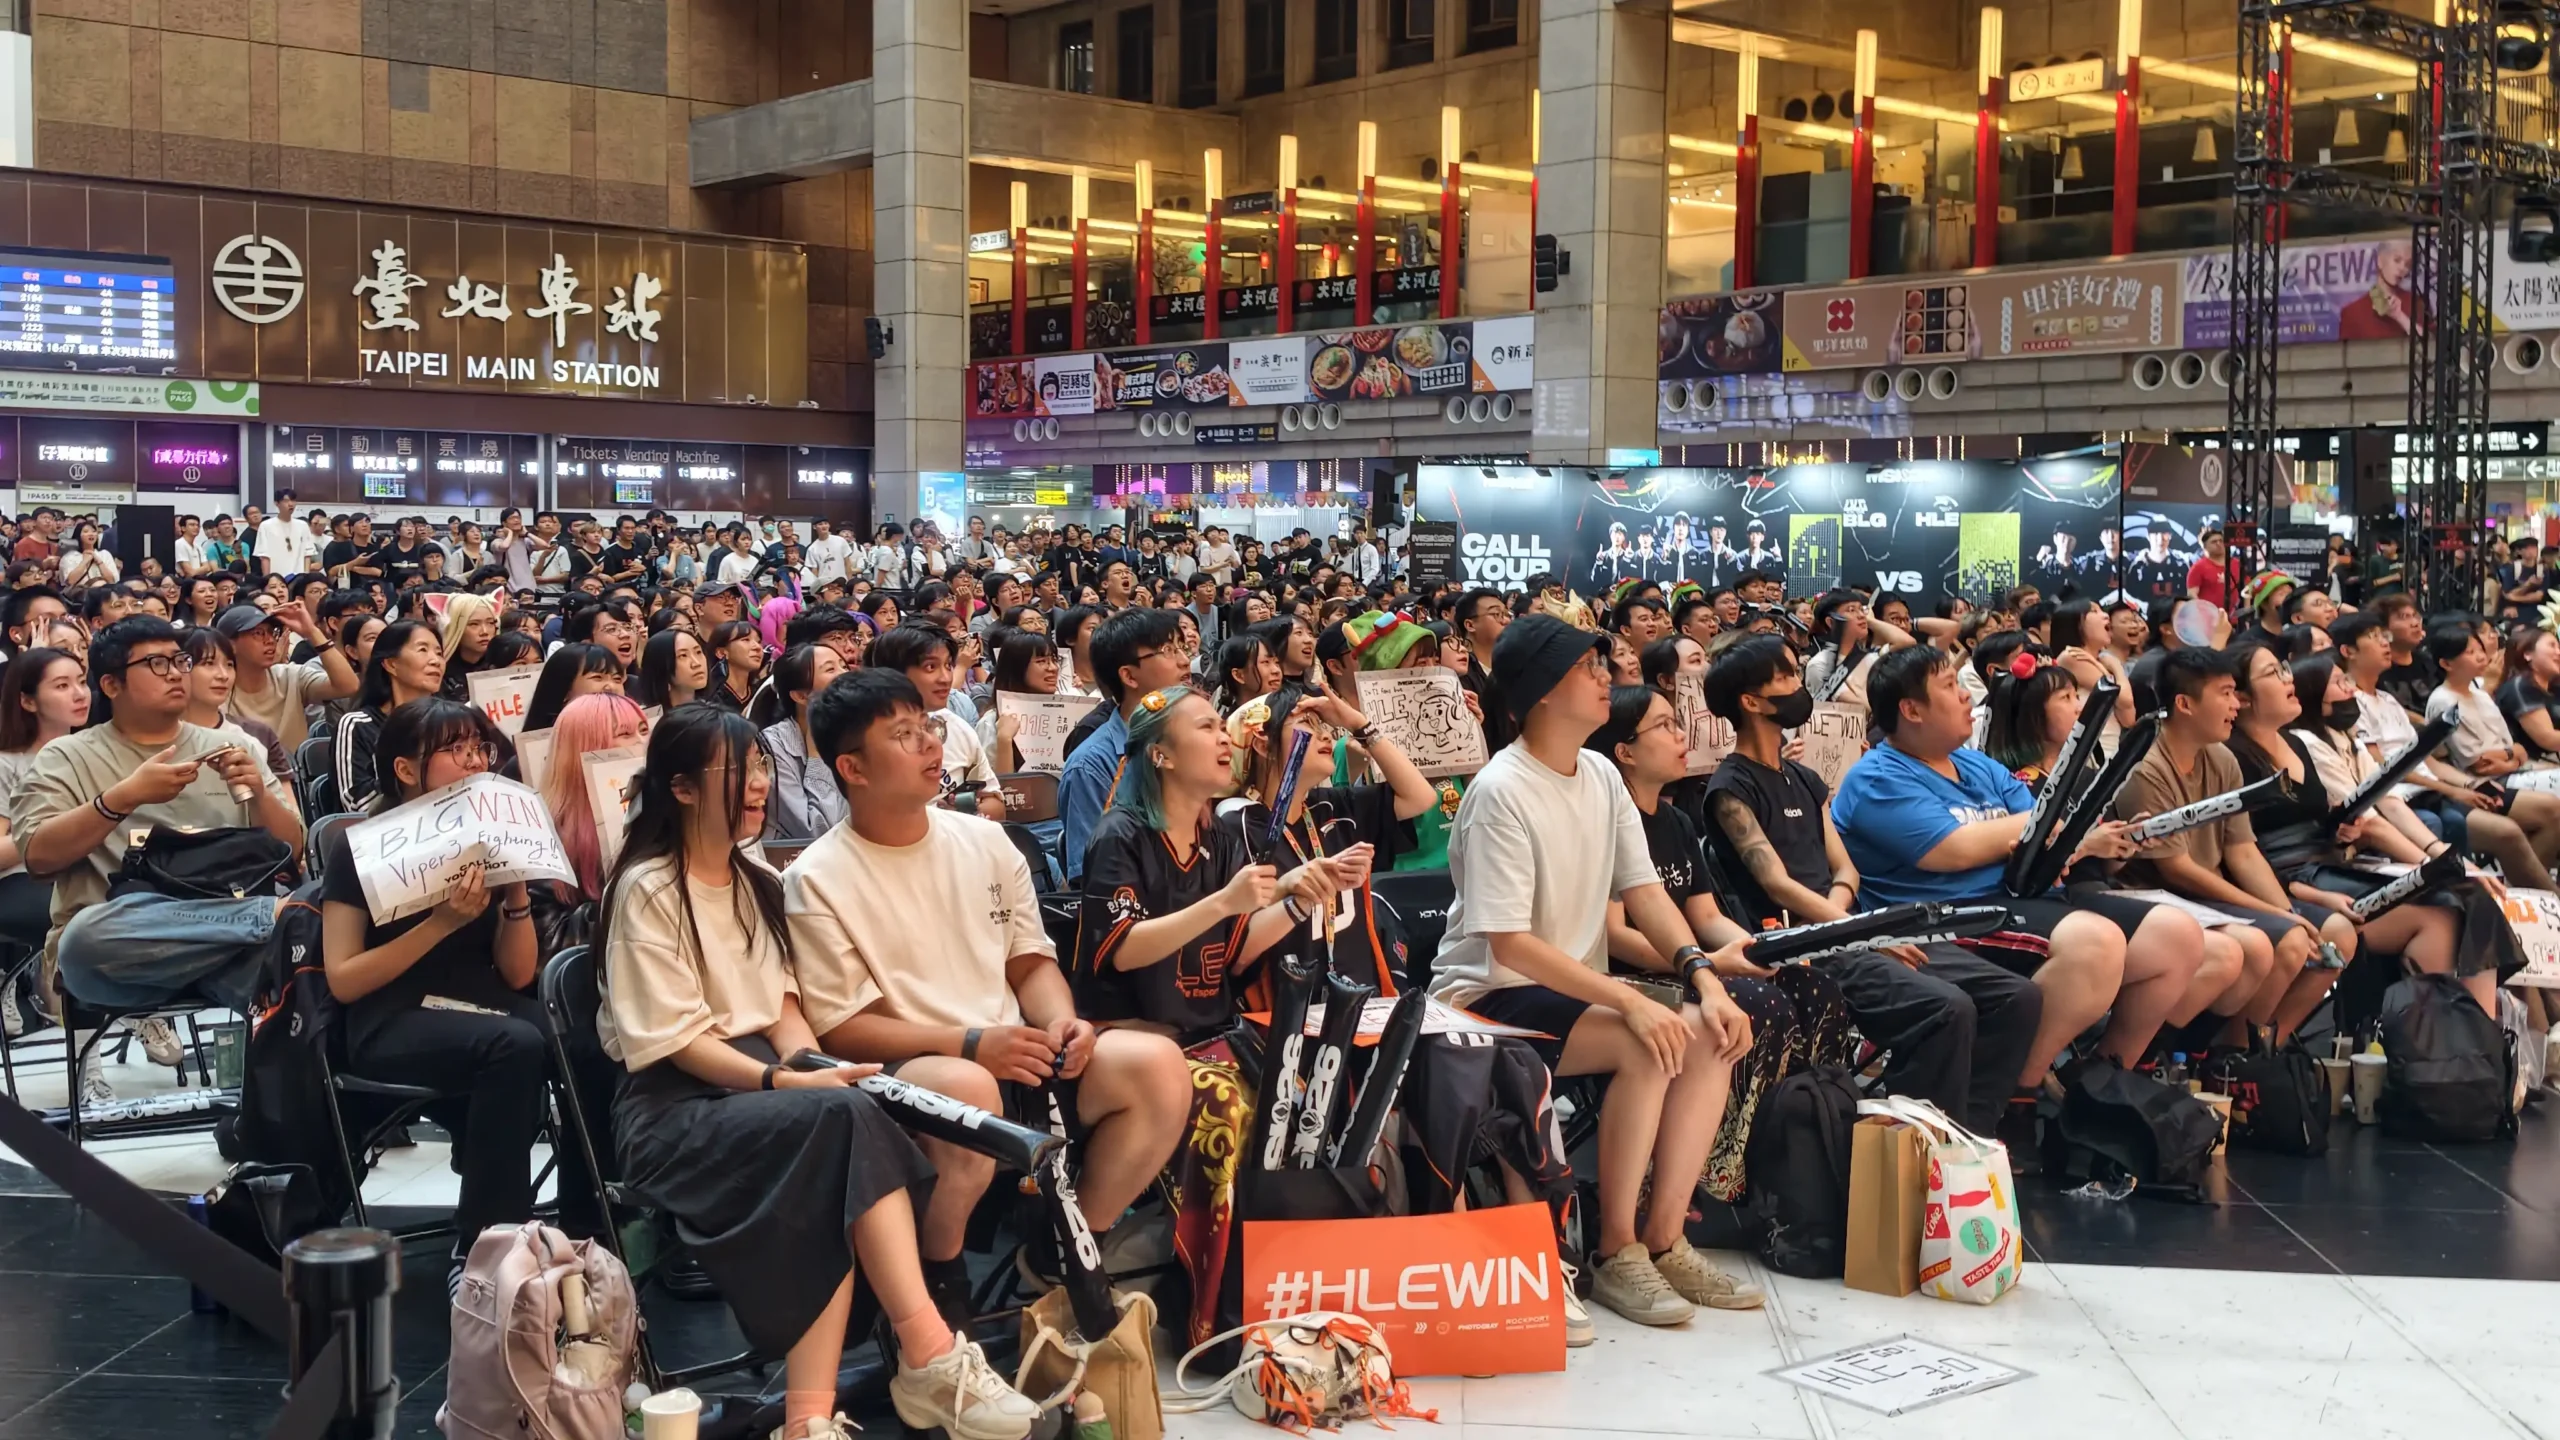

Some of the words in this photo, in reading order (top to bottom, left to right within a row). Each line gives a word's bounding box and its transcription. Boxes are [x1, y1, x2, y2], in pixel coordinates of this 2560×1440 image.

[352, 239, 662, 348] 臺北車站
[361, 349, 448, 376] TAIPEI
[467, 356, 535, 381] MAIN
[553, 359, 660, 388] STATION
[1785, 358, 1799, 369] 1F
[306, 433, 499, 458] 自動售票機
[572, 446, 618, 461] Tickets
[624, 448, 669, 464] Vending
[676, 450, 720, 464] Machine
[1843, 513, 1887, 528] BLG
[1916, 512, 1959, 527] HLE
[1461, 532, 1551, 557] CALL
[1461, 557, 1551, 581] YOUR
[1876, 571, 1924, 593] VS
[486, 693, 524, 722] HLE
[380, 801, 464, 860] BLG
[467, 791, 543, 830] WIN
[444, 869, 468, 884] YOU
[484, 860, 509, 871] HOT
[1263, 1252, 1549, 1320] #HLEWIN
[1966, 1265, 1990, 1284] TASTE
[1801, 1357, 1907, 1390] HLE
